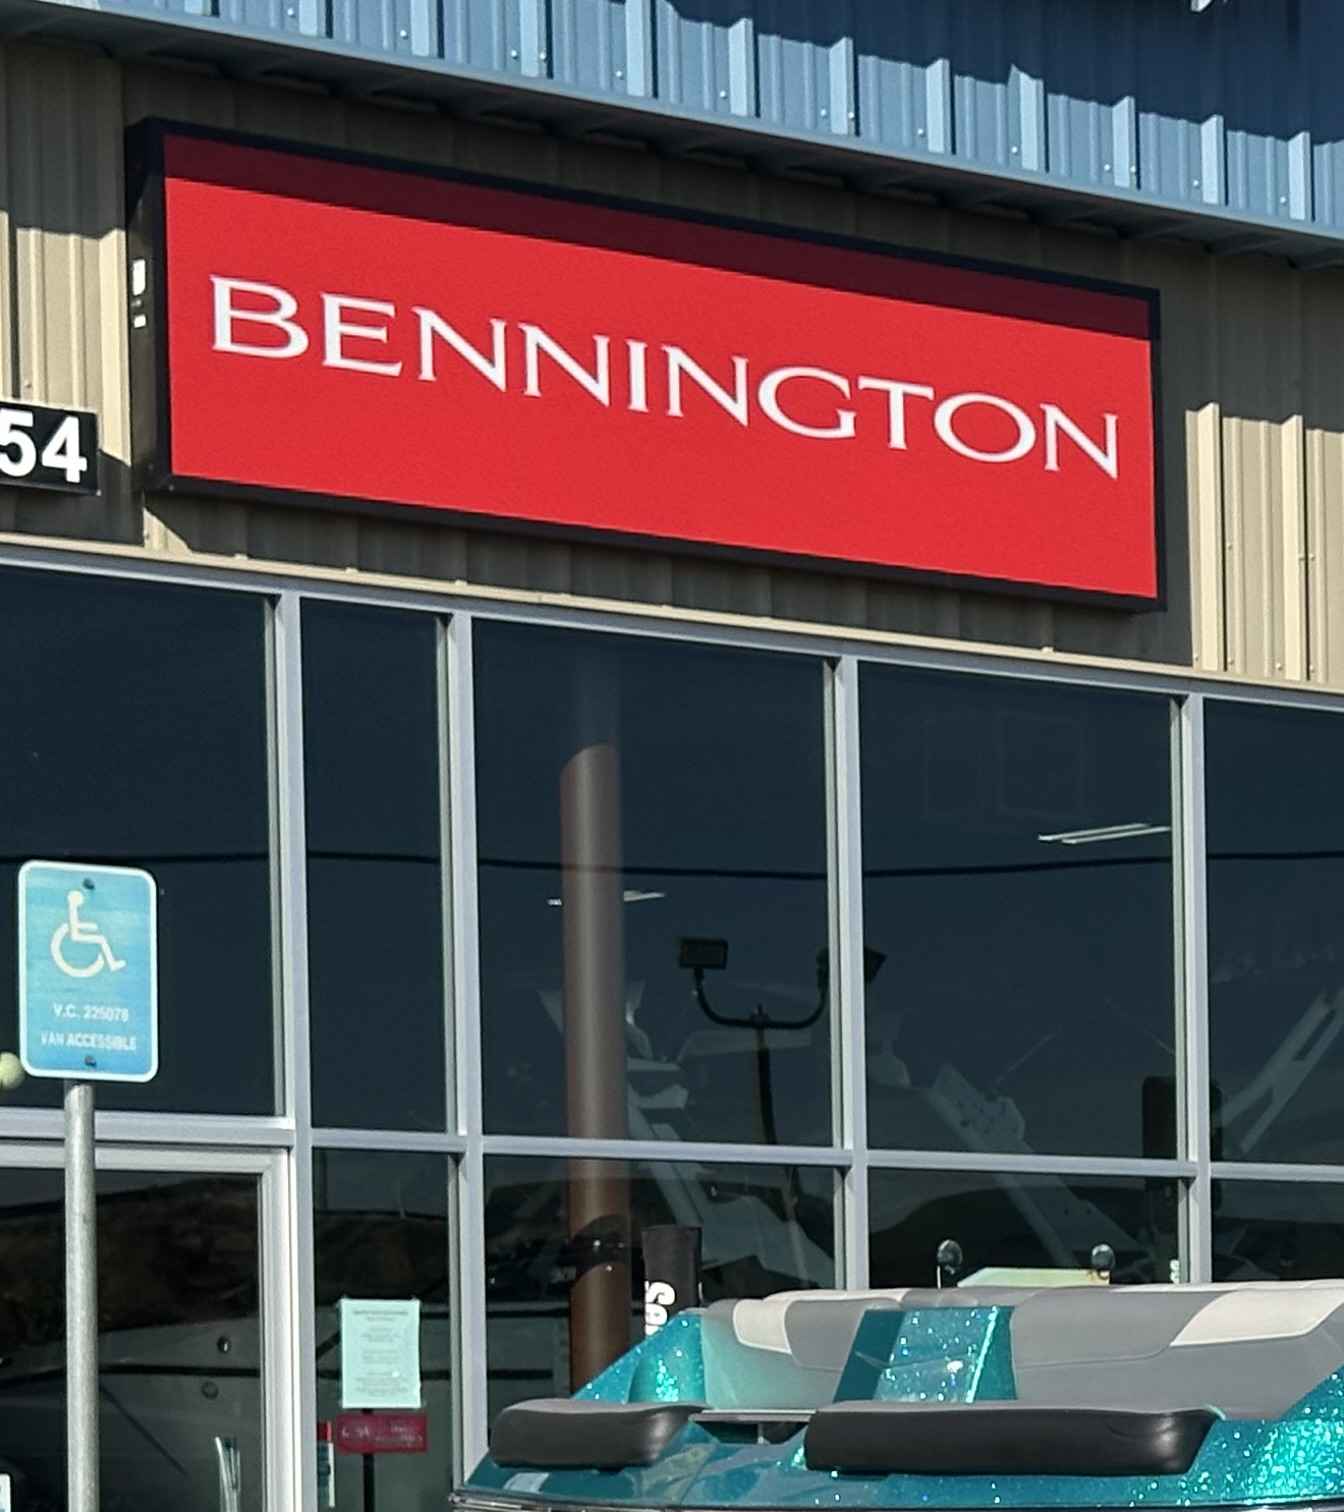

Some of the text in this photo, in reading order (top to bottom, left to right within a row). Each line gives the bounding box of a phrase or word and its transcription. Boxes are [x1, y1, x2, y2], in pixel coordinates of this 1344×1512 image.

[209, 273, 1120, 480] BENNINGTON
[0, 407, 88, 484] 54
[40, 1031, 137, 1051] VAN ACCESSIBLE
